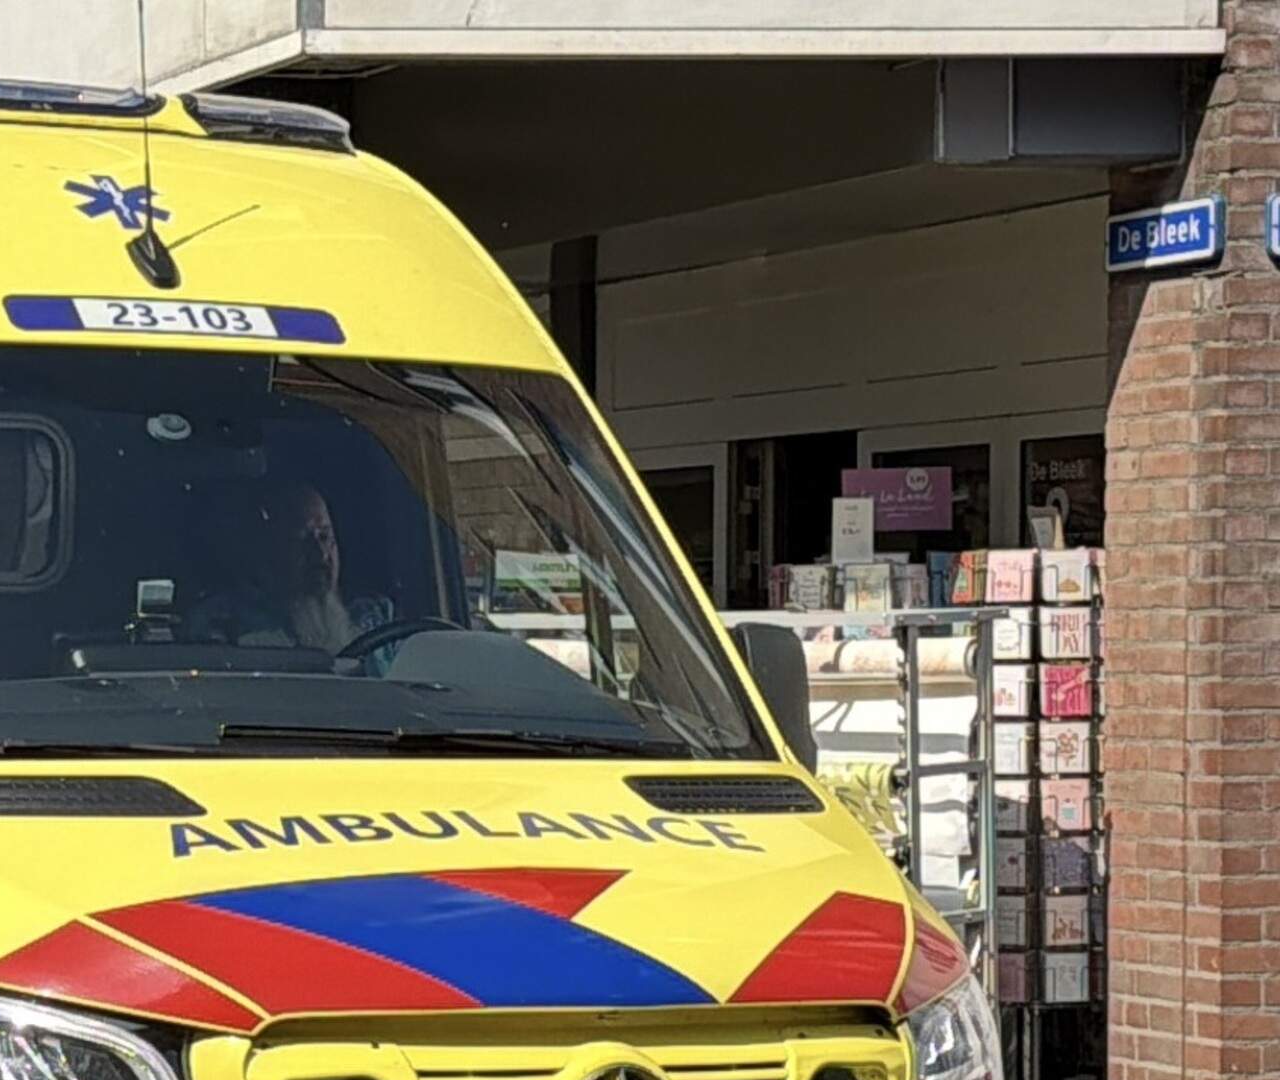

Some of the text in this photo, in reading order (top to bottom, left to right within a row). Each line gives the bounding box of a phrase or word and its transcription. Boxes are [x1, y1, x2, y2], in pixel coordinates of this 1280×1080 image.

[1118, 212, 1201, 252] De Bleek
[106, 302, 253, 332] 23-103
[170, 808, 766, 858] AMBULANCE
